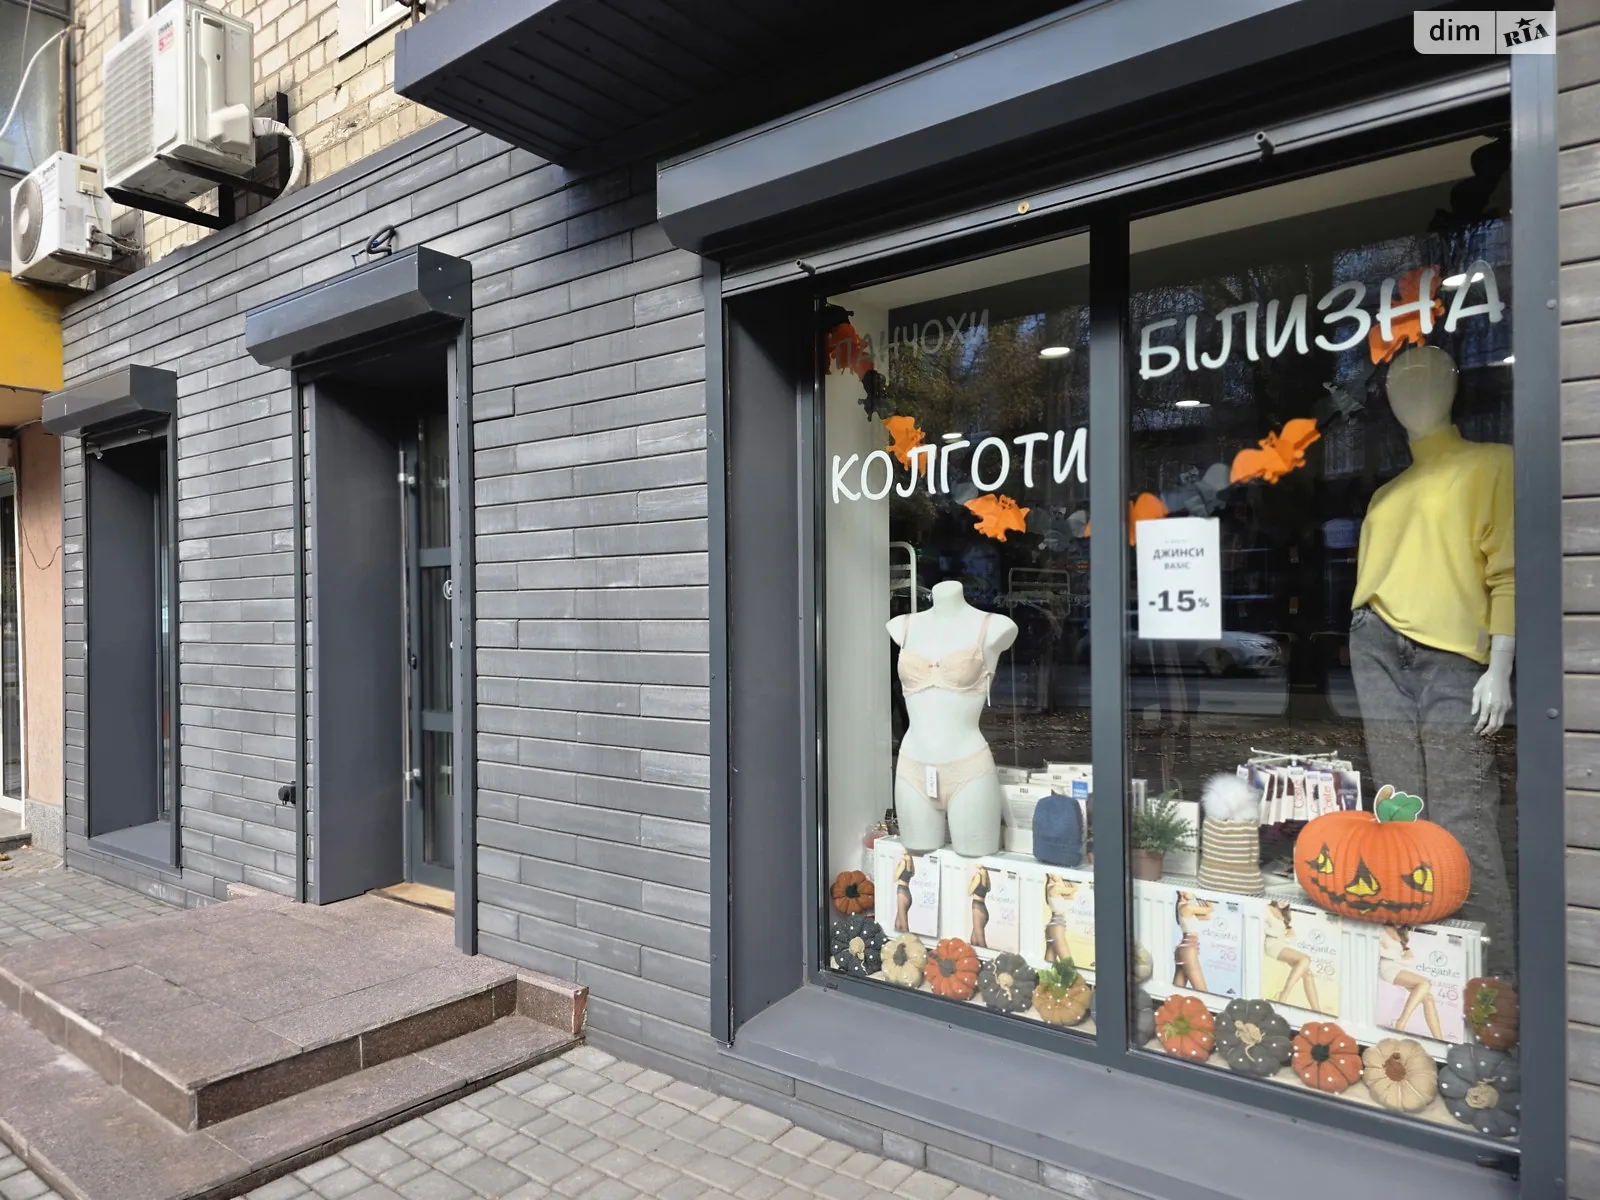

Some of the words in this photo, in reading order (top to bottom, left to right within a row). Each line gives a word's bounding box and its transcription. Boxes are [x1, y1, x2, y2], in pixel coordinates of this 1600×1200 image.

[1138, 259, 1505, 380] БІЛИЗНА
[834, 308, 990, 370] ПАНЧОХИ
[832, 427, 1088, 504] КОЛГОТИ
[1152, 547, 1205, 560] ДЖИНСИ
[1164, 562, 1191, 570] BASIC
[1297, 940, 1337, 956] elegante
[1316, 964, 1335, 976] 20
[1416, 962, 1461, 979] elegante
[1437, 988, 1459, 1001] 40
